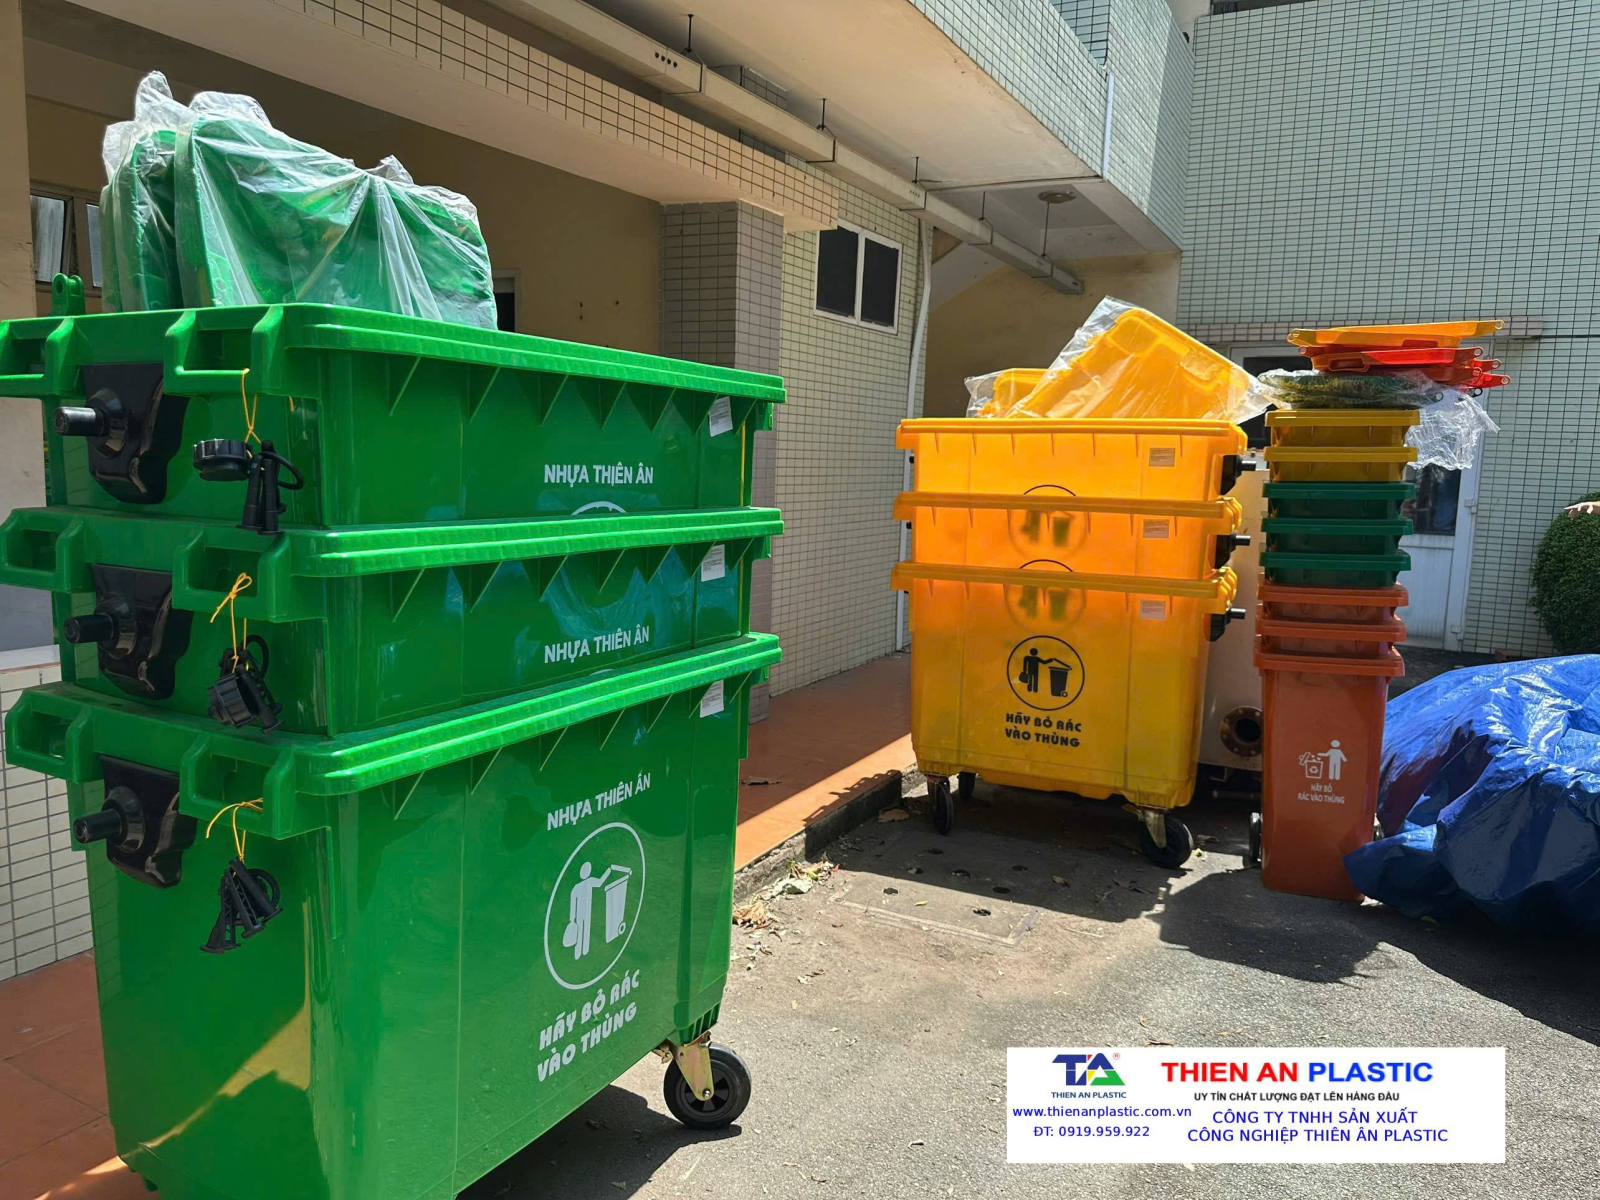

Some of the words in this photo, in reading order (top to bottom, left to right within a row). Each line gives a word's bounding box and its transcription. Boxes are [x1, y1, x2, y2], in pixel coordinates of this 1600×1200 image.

[544, 464, 589, 488] NHỰA
[635, 461, 654, 484] ÂN
[544, 639, 590, 664] NHỰA
[594, 627, 631, 654] THIÊN
[634, 623, 650, 646] ÂN
[1005, 725, 1031, 740] VÀO
[1034, 731, 1080, 747] THÙNG
[1006, 711, 1031, 725] HÃY
[1034, 715, 1053, 728] BỎ
[1056, 718, 1082, 732] RÁC
[547, 798, 593, 831] NHỰA
[595, 781, 633, 811] THIÊN
[1297, 791, 1310, 801] RÁC
[1310, 792, 1323, 802] VÀO
[581, 988, 606, 1024] BỎ
[610, 969, 640, 1005] RÁC
[537, 1043, 576, 1082] VÀO
[580, 1002, 637, 1054] THÙNG
